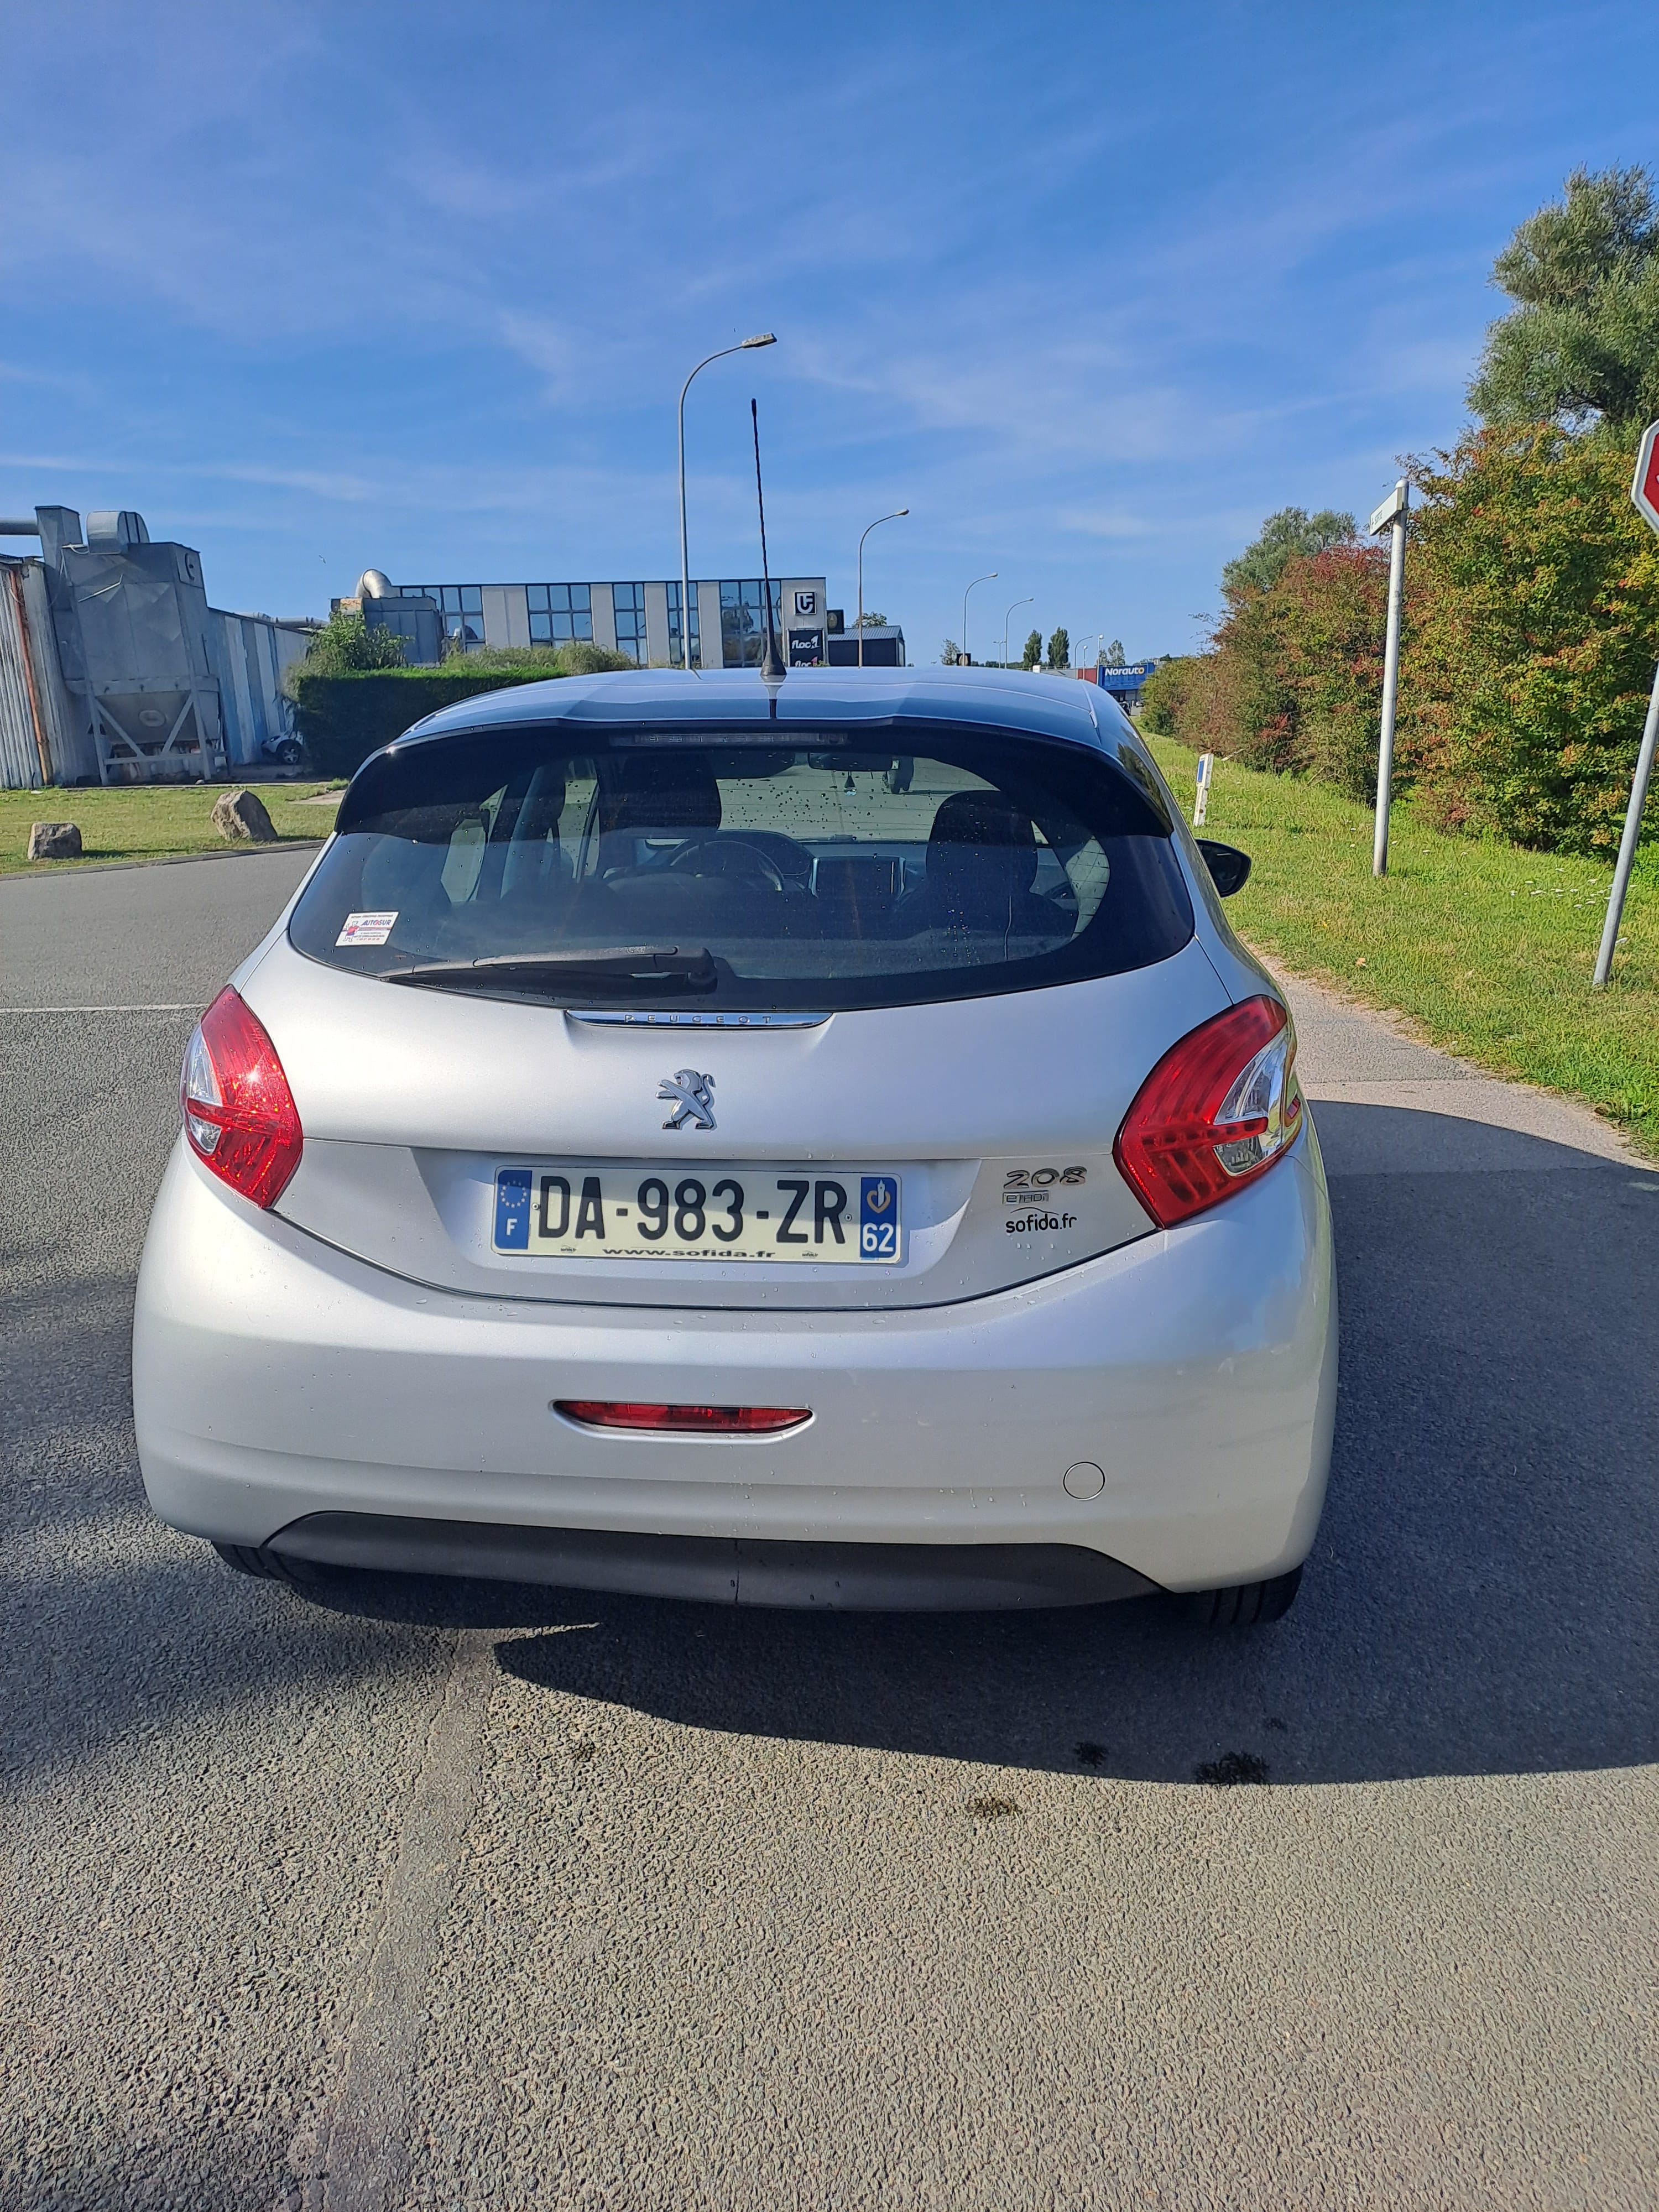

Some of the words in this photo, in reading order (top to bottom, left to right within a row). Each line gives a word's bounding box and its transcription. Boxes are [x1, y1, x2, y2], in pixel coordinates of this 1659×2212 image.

[1105, 667, 1145, 676] Norauto
[624, 1014, 772, 1023] PEUGEOT
[1003, 1166, 1087, 1190] 208
[538, 1176, 846, 1244] DA-983-ZR
[506, 1218, 518, 1236] F
[1005, 1213, 1077, 1233] sofida.fr
[862, 1223, 894, 1252] 62
[602, 1249, 776, 1258] www.sofida.fr
